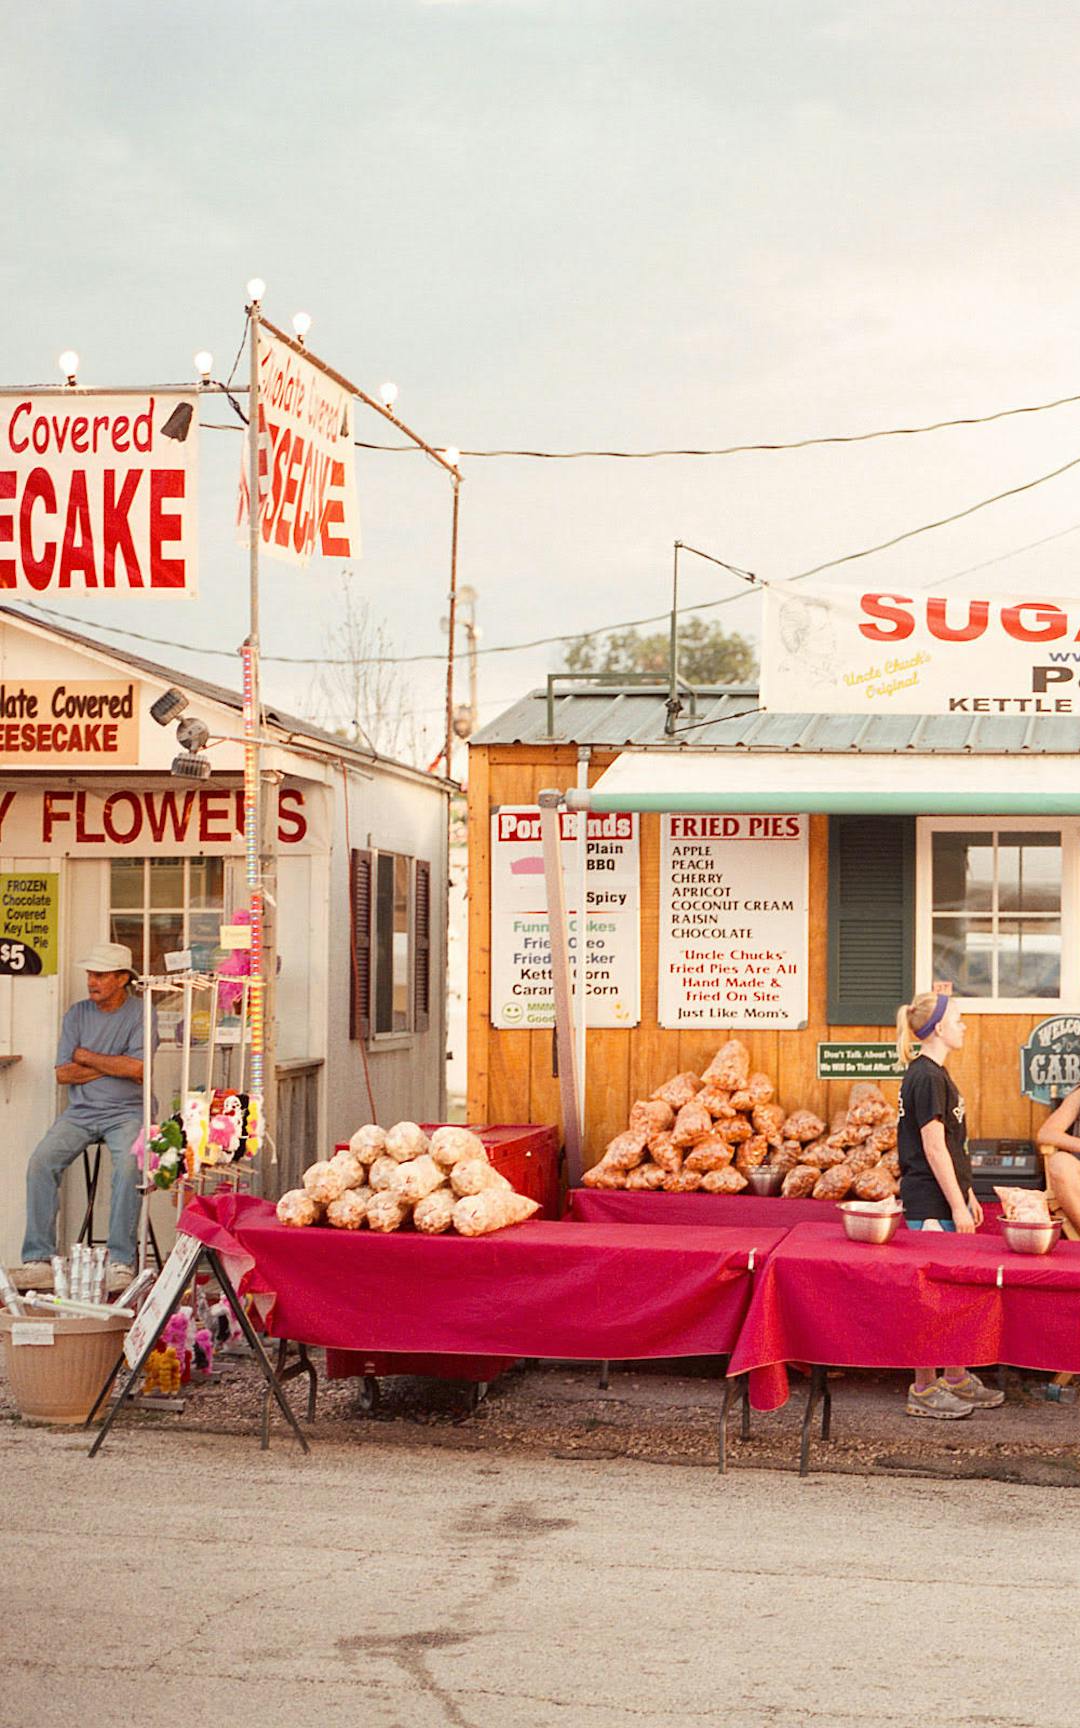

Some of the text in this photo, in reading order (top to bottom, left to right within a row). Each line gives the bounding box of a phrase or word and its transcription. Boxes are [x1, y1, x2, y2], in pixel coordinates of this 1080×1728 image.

[9, 397, 155, 454] Covered
[843, 665, 881, 687] Uncle
[52, 685, 133, 719] Covered
[949, 698, 1072, 712] KETTLE
[501, 813, 631, 838] Por Rnds
[671, 818, 800, 836] FRIED PIES
[586, 843, 623, 854] Plain
[672, 847, 712, 856] APPLE
[587, 859, 615, 871] BBQ
[672, 860, 714, 870] PEACH
[671, 873, 723, 884] CHERRY
[8, 880, 47, 892] FROZEN
[672, 887, 731, 897] APRICOT
[3, 894, 51, 906] Chocolate
[586, 892, 626, 905] Spicy
[671, 901, 794, 911] COCONUT CREAM
[7, 908, 46, 920] Covered
[672, 915, 718, 924] RAISIN
[4, 922, 48, 936] Key Lime
[671, 928, 752, 939] CHOCOLATE
[33, 936, 48, 949] Pie
[524, 937, 605, 949] Frie Oeo
[0, 943, 25, 971] $5
[513, 953, 551, 965] Fried
[521, 968, 552, 980] Kett
[670, 963, 797, 974] Fried Pies Are All
[682, 978, 781, 988] Hand Made &
[686, 991, 780, 1001] Fried On Site
[678, 1008, 788, 1019] Just Like Mom's
